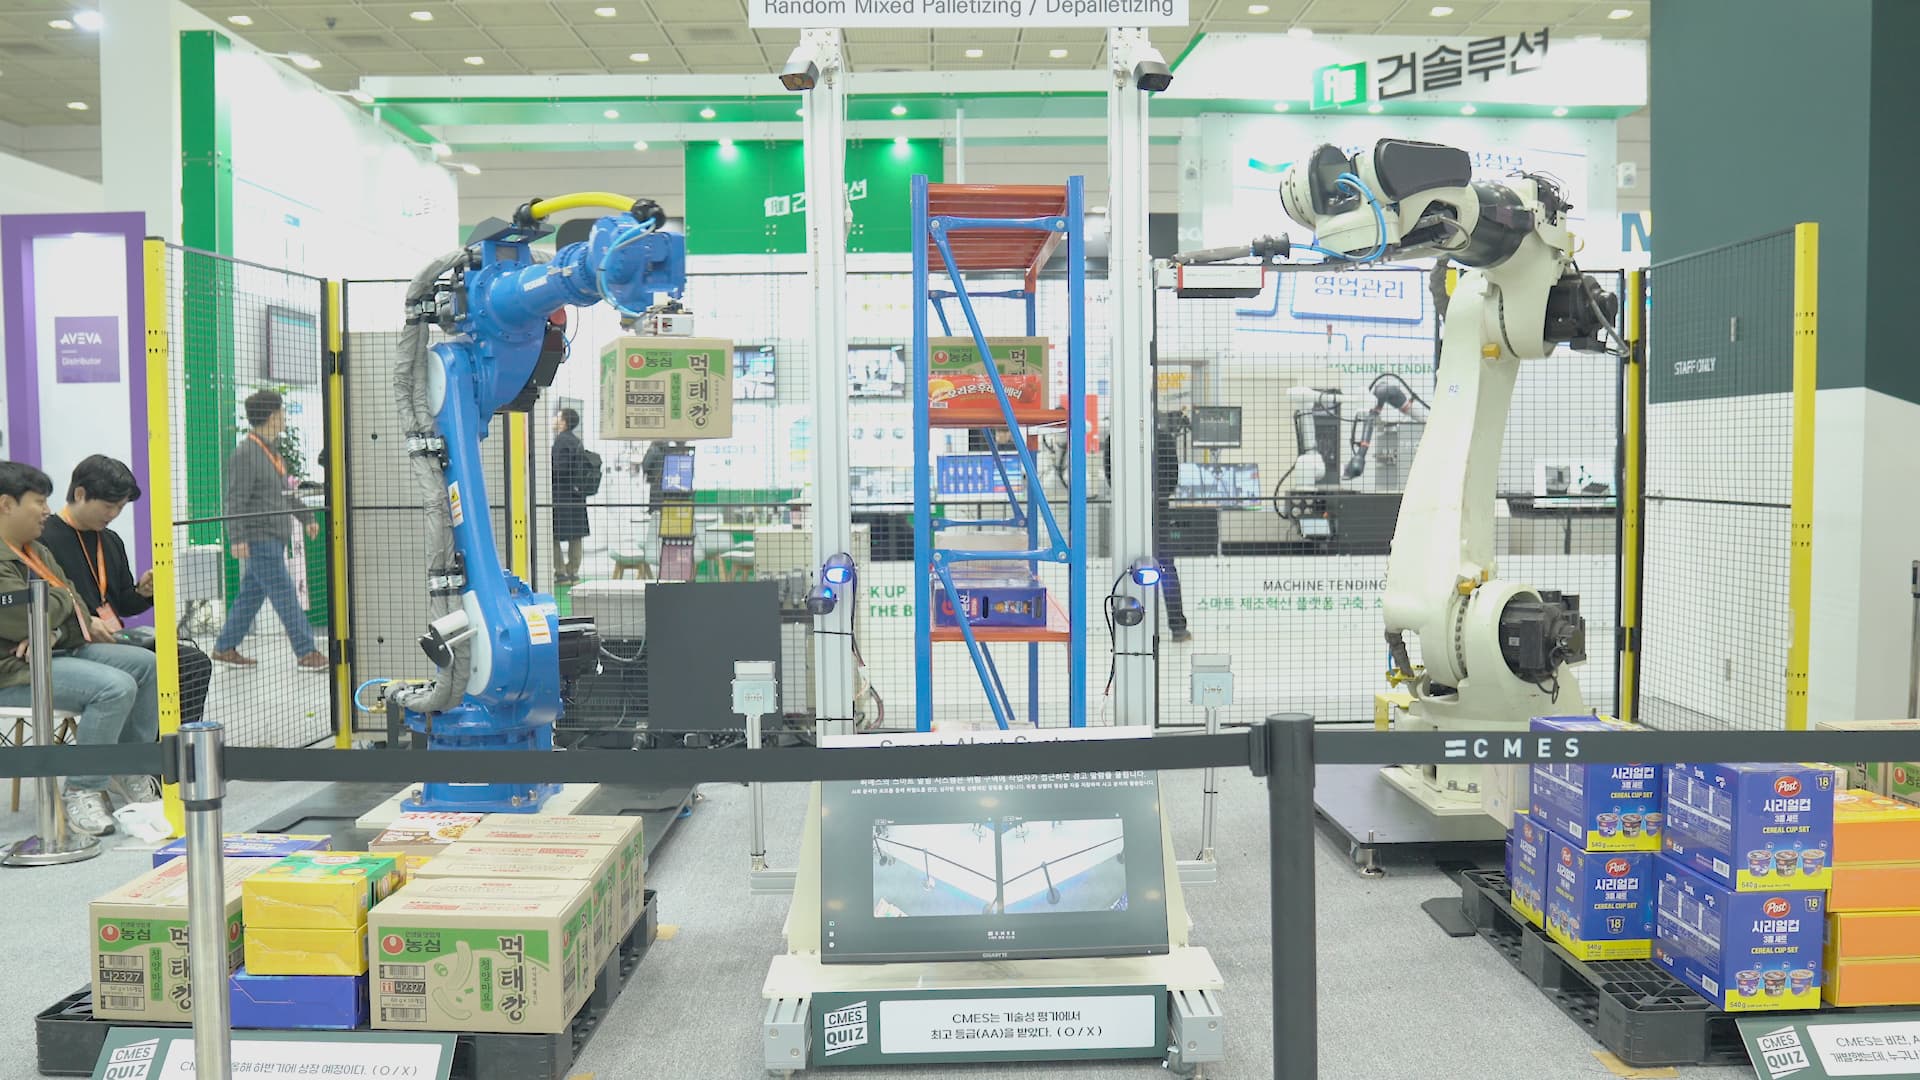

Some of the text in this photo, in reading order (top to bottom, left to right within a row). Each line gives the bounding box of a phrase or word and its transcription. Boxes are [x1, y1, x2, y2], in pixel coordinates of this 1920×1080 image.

[764, 0, 846, 15] Random
[855, 0, 915, 15] Mixed
[922, 0, 1022, 18] Palletizing
[1045, 0, 1174, 18] Depalletizing
[1377, 27, 1550, 101] 건솔루션
[1313, 274, 1404, 300] 영업관리
[60, 331, 102, 345] AVEVA
[645, 356, 673, 369] 농심
[1673, 356, 1718, 376] STAFF ONLY
[688, 353, 710, 427] 먹태깡
[627, 394, 663, 405] 나2327
[884, 585, 906, 599] UP
[1263, 578, 1387, 592] MACHINE TENDING
[1472, 737, 1580, 759] CMES
[1611, 766, 1655, 780] 시리얼컵
[1777, 780, 1798, 794] Post
[1818, 776, 1829, 787] 18
[1763, 798, 1811, 812] 시리얼컵
[1762, 826, 1786, 834] CEREAL
[1798, 825, 1811, 833] SET
[1608, 861, 1626, 873] Post
[1594, 878, 1639, 891] 시리얼컵
[1593, 902, 1615, 910] CEREAL
[1767, 901, 1786, 915] Post
[1807, 898, 1818, 908] 18
[1610, 918, 1621, 929] 18
[1752, 920, 1800, 934] 시리얼컵
[119, 927, 151, 942] 농심
[405, 938, 441, 953] 농심
[1751, 946, 1799, 955] CEREAL CUP SET
[102, 970, 141, 984] 나2327
[500, 935, 527, 1022] 먹태깡
[395, 981, 425, 994] 나2327
[828, 1010, 863, 1025] CMES
[952, 1010, 1081, 1024] CMES는 기술성 평가에서
[826, 1027, 864, 1046] QUIZ
[930, 1029, 952, 1040] 최고
[955, 1027, 1014, 1040] 등급(AA)을
[1016, 1027, 1052, 1038] 받았다.
[1762, 1034, 1796, 1050] CMES
[1836, 1034, 1884, 1048] CMES는
[1884, 1034, 1912, 1048] 비전,
[115, 1046, 152, 1061] CMES
[1767, 1050, 1805, 1069] QUIZ
[1830, 1051, 1889, 1064] 개발했는데,
[106, 1063, 147, 1080] QUIZ
[253, 1062, 297, 1074] 하반기에
[298, 1063, 320, 1075] 상장
[321, 1063, 367, 1076] 예정이다.
